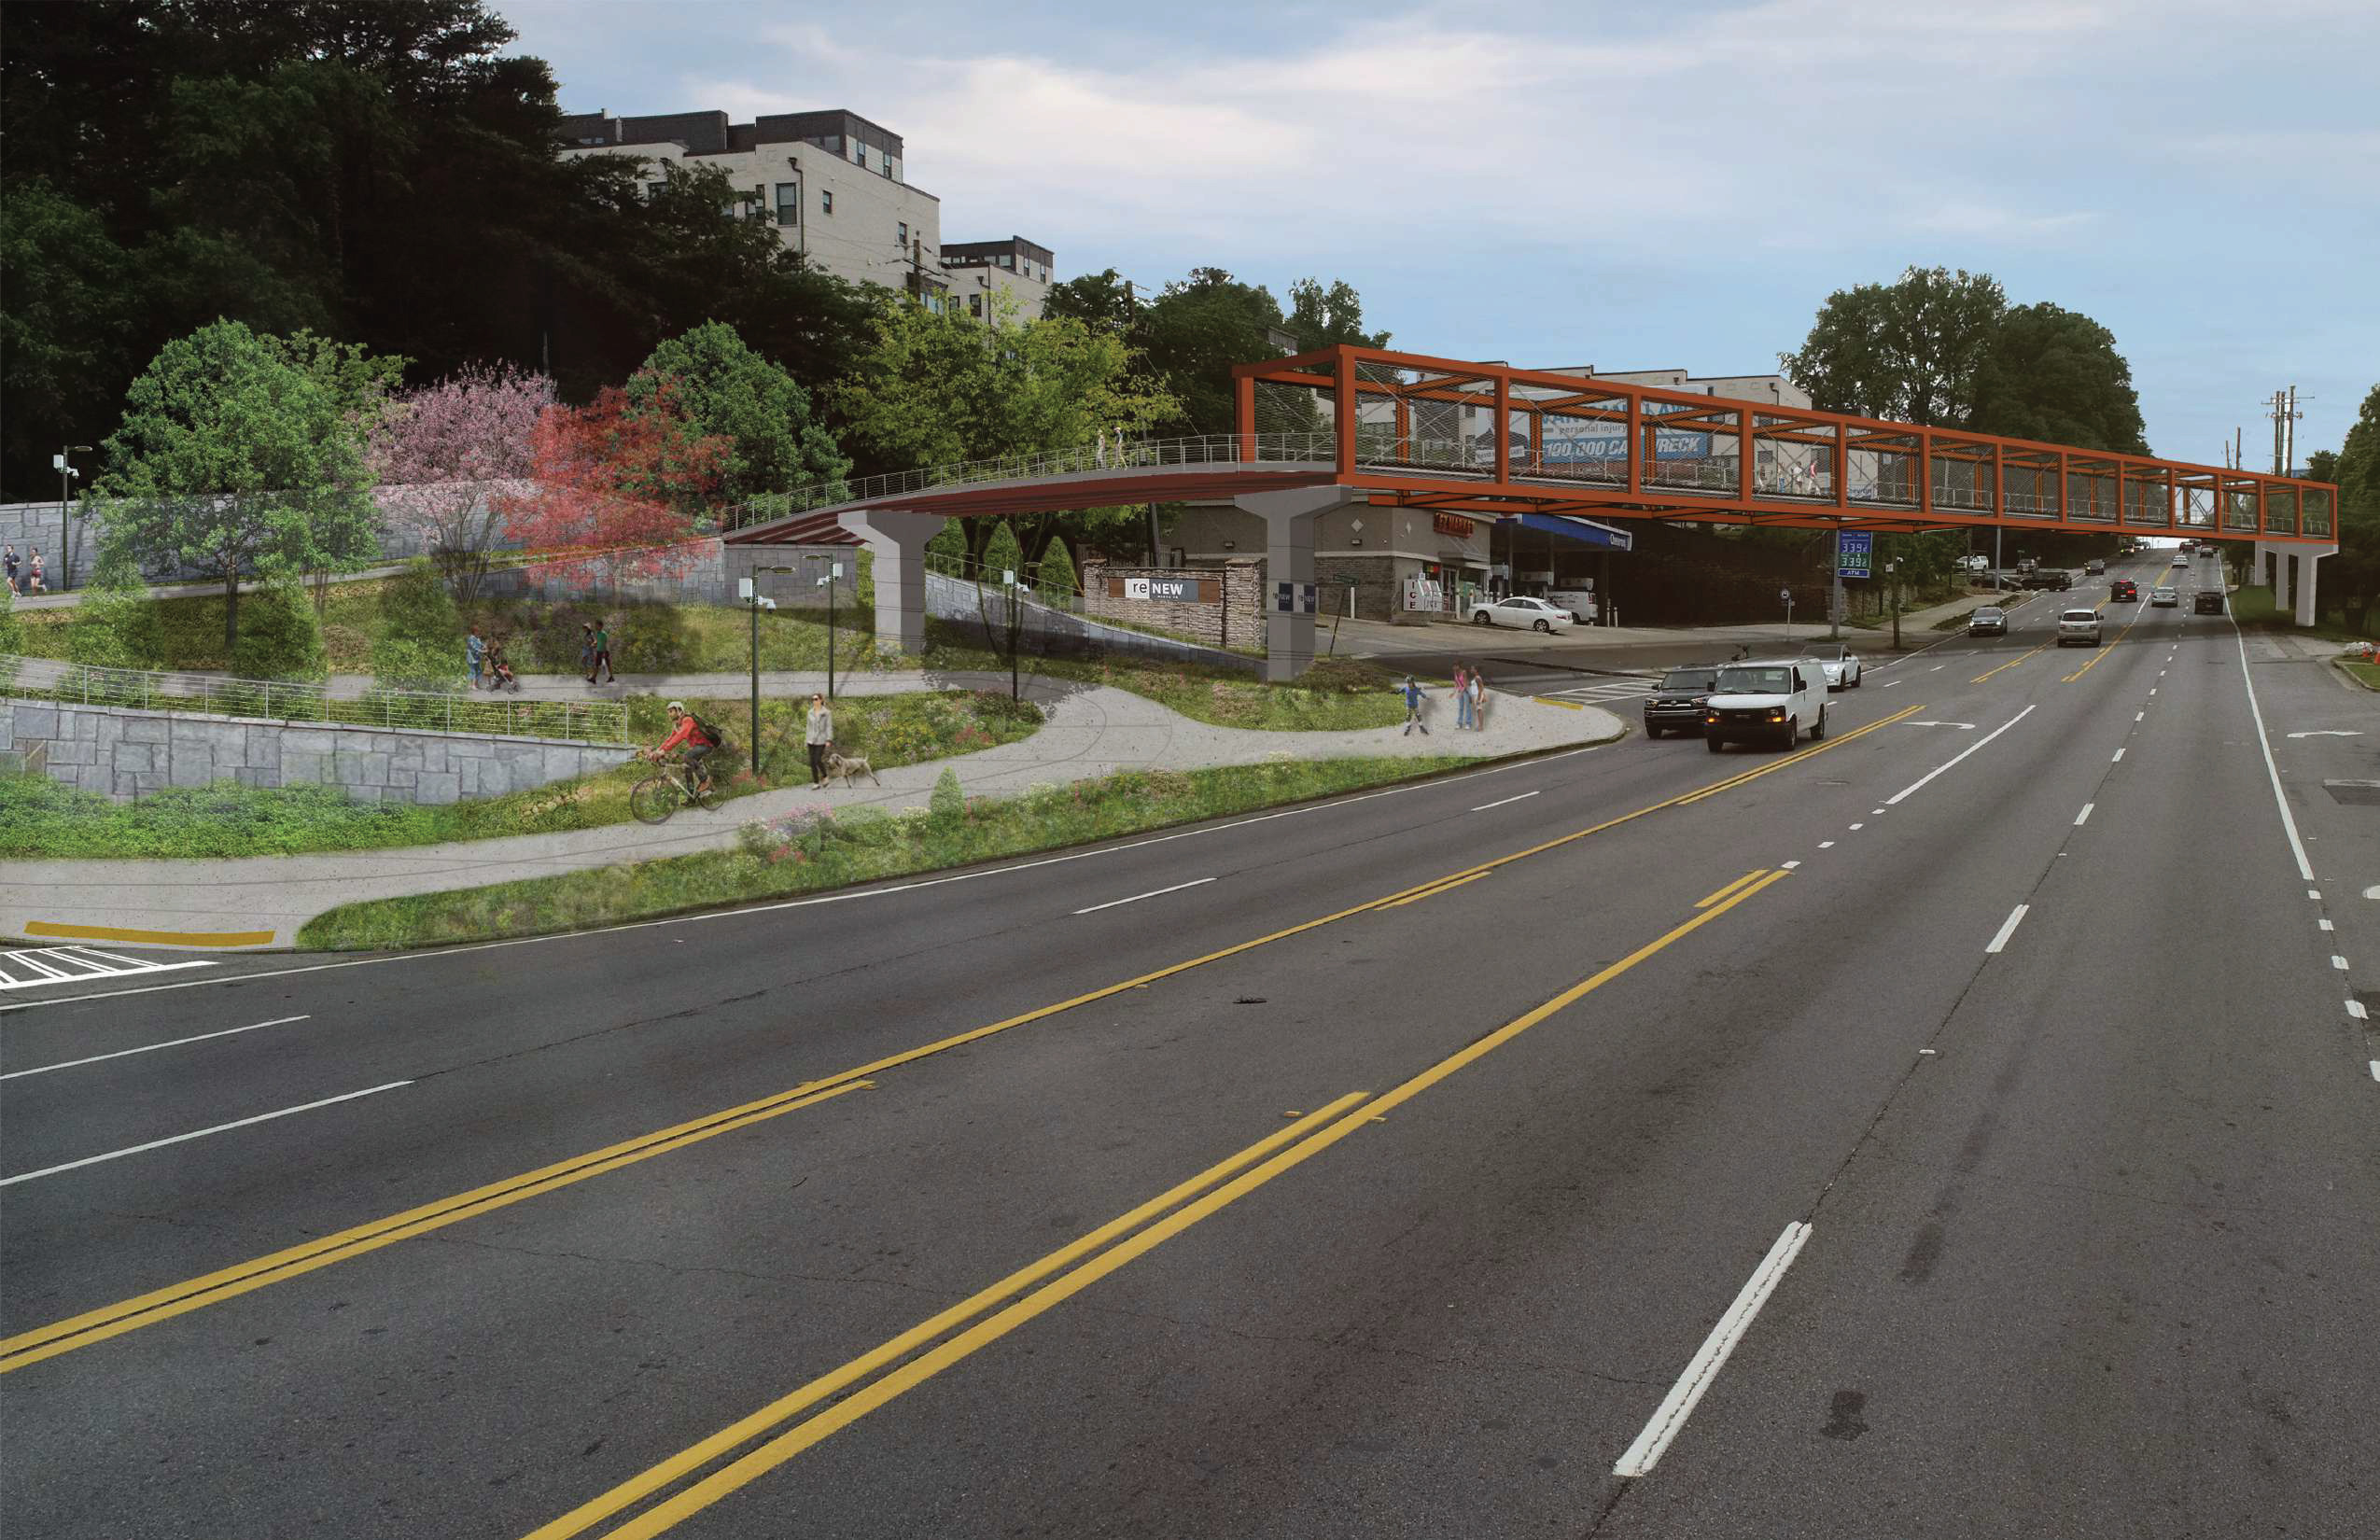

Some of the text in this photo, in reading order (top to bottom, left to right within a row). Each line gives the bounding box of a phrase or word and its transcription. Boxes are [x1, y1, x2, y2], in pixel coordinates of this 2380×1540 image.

[1559, 422, 1627, 435] personal injury
[1608, 440, 1628, 455] CA
[1656, 438, 1701, 454] RECK
